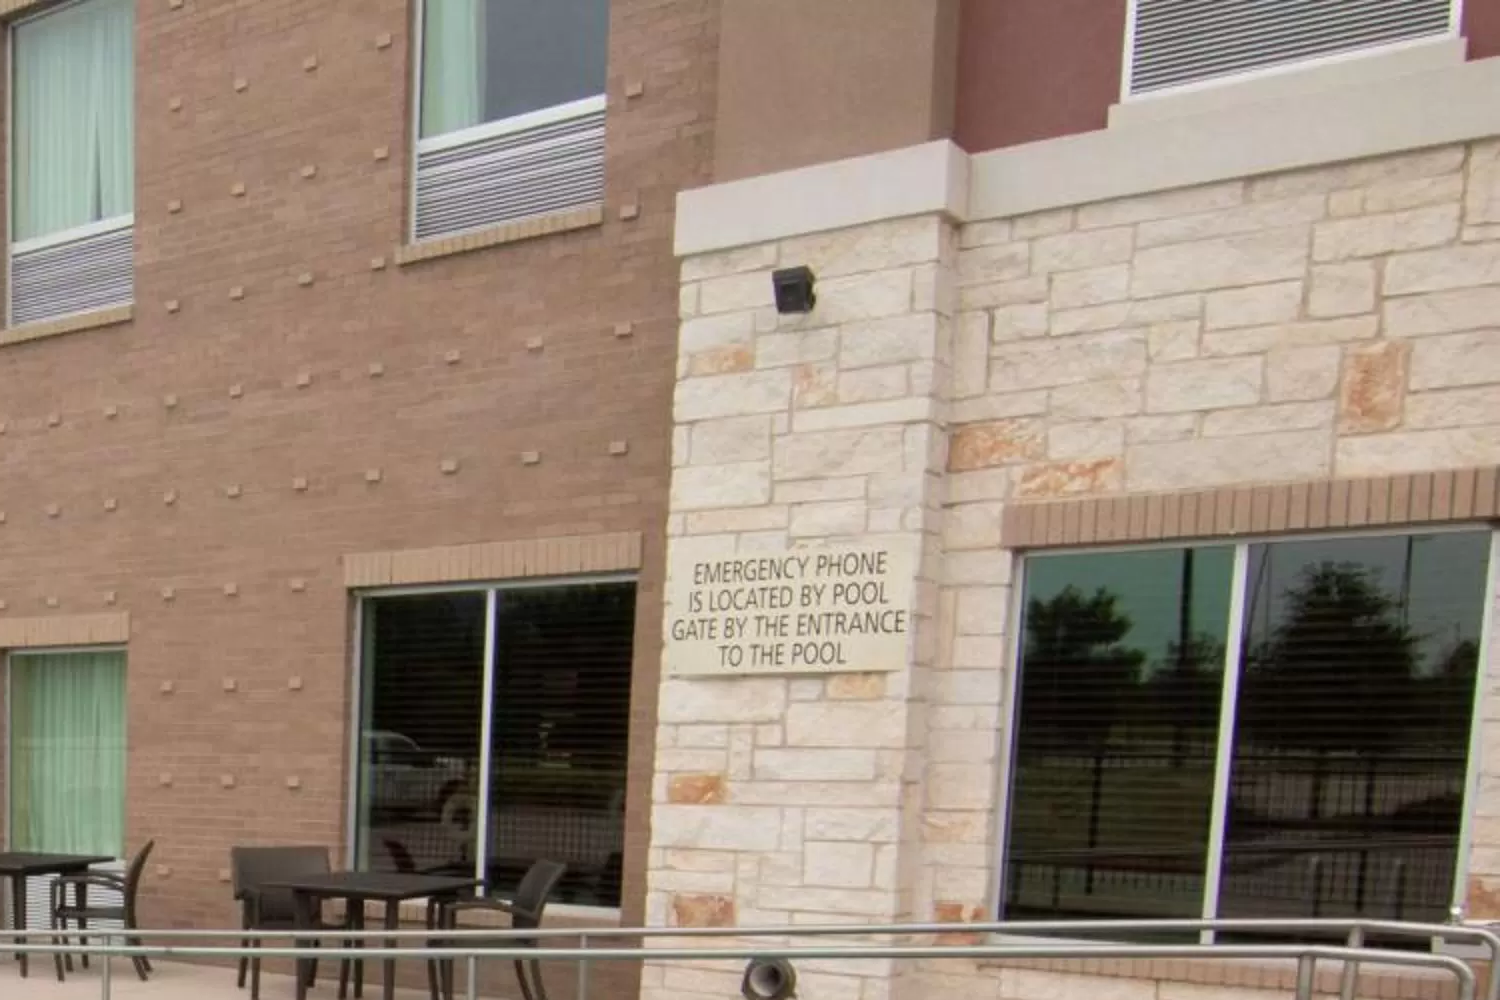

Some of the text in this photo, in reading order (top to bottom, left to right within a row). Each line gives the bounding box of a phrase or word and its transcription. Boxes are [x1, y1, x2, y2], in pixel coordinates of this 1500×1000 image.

[693, 551, 888, 585] EMERGENCY PHONE
[688, 581, 889, 613] IS LOCATED BY POOL
[671, 609, 906, 641] GATE BY THE ENTRANCE
[717, 641, 847, 668] TO THE POOL
